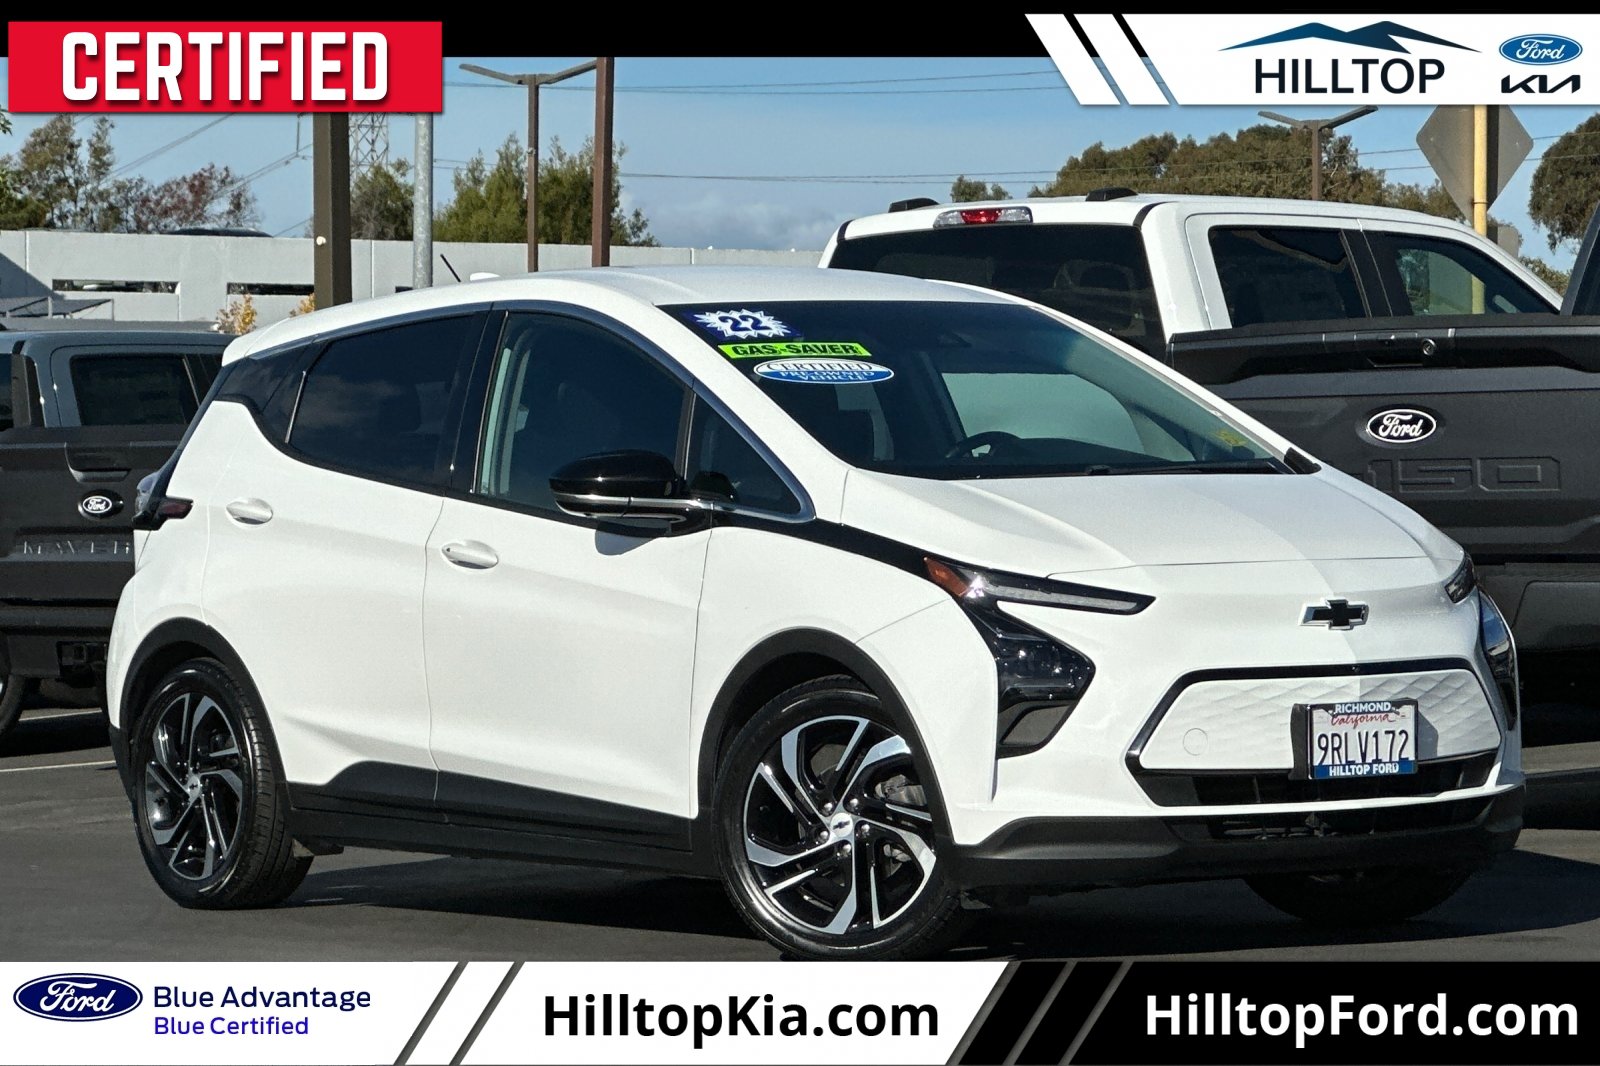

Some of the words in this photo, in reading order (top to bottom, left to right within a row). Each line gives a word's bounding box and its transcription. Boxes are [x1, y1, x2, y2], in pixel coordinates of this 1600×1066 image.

[717, 314, 773, 333] 22
[766, 362, 873, 372] CERTIFIED
[1378, 412, 1424, 438] Ford
[87, 498, 107, 511] Ford
[1334, 701, 1392, 714] RICHMOND
[1330, 713, 1396, 730] California
[1317, 729, 1410, 766] 9RLV172
[1328, 764, 1370, 777] HILLTOP
[1372, 763, 1399, 775] FORD
